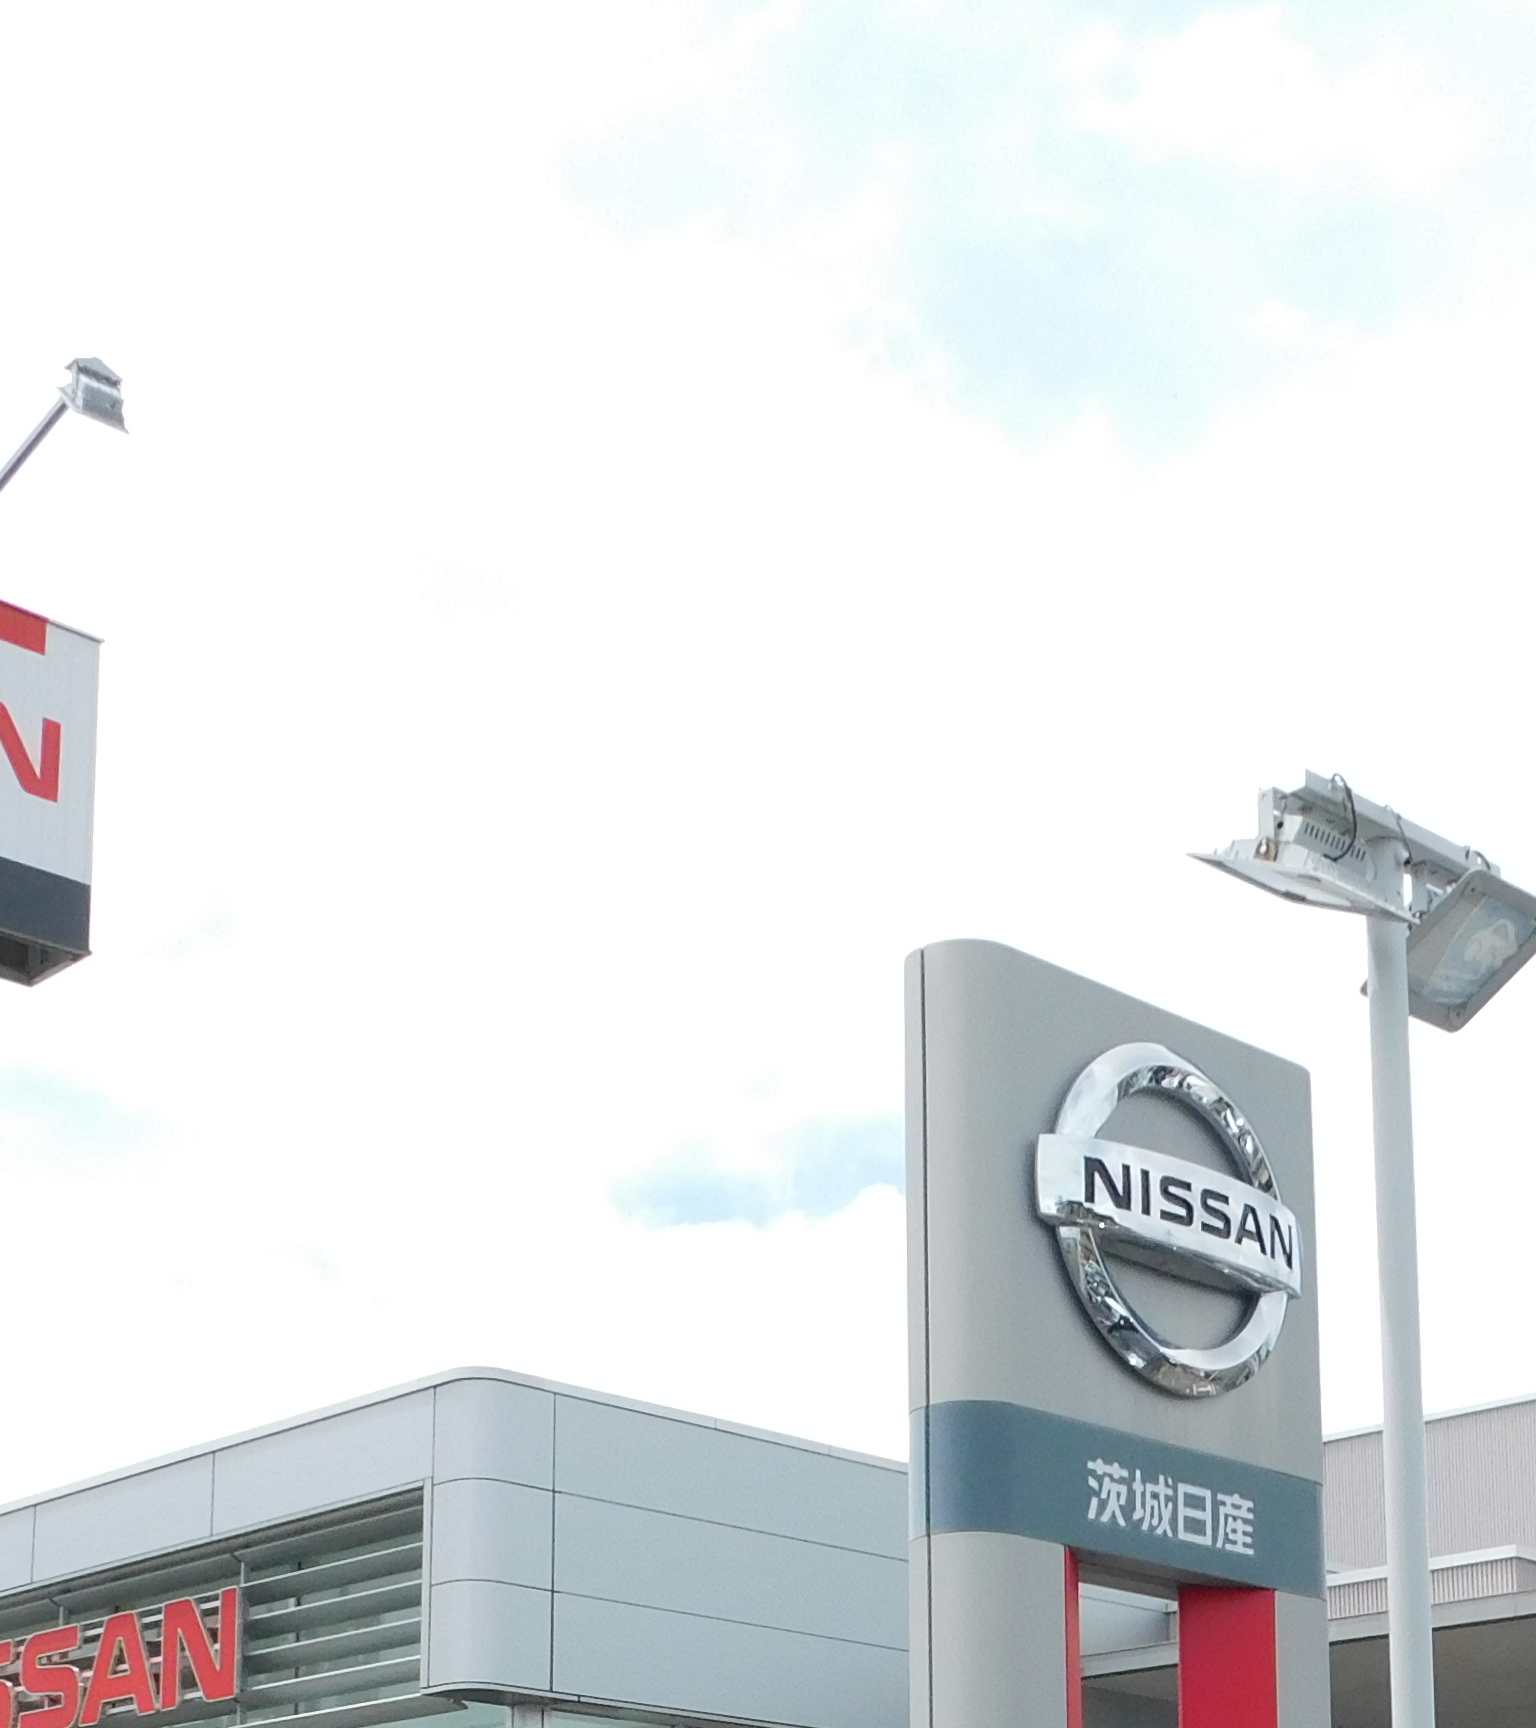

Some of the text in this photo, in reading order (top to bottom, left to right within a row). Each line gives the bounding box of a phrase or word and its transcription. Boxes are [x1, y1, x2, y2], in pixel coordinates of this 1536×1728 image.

[1083, 1156, 1296, 1271] NISSAN
[1086, 1458, 1255, 1556] 茨城日産
